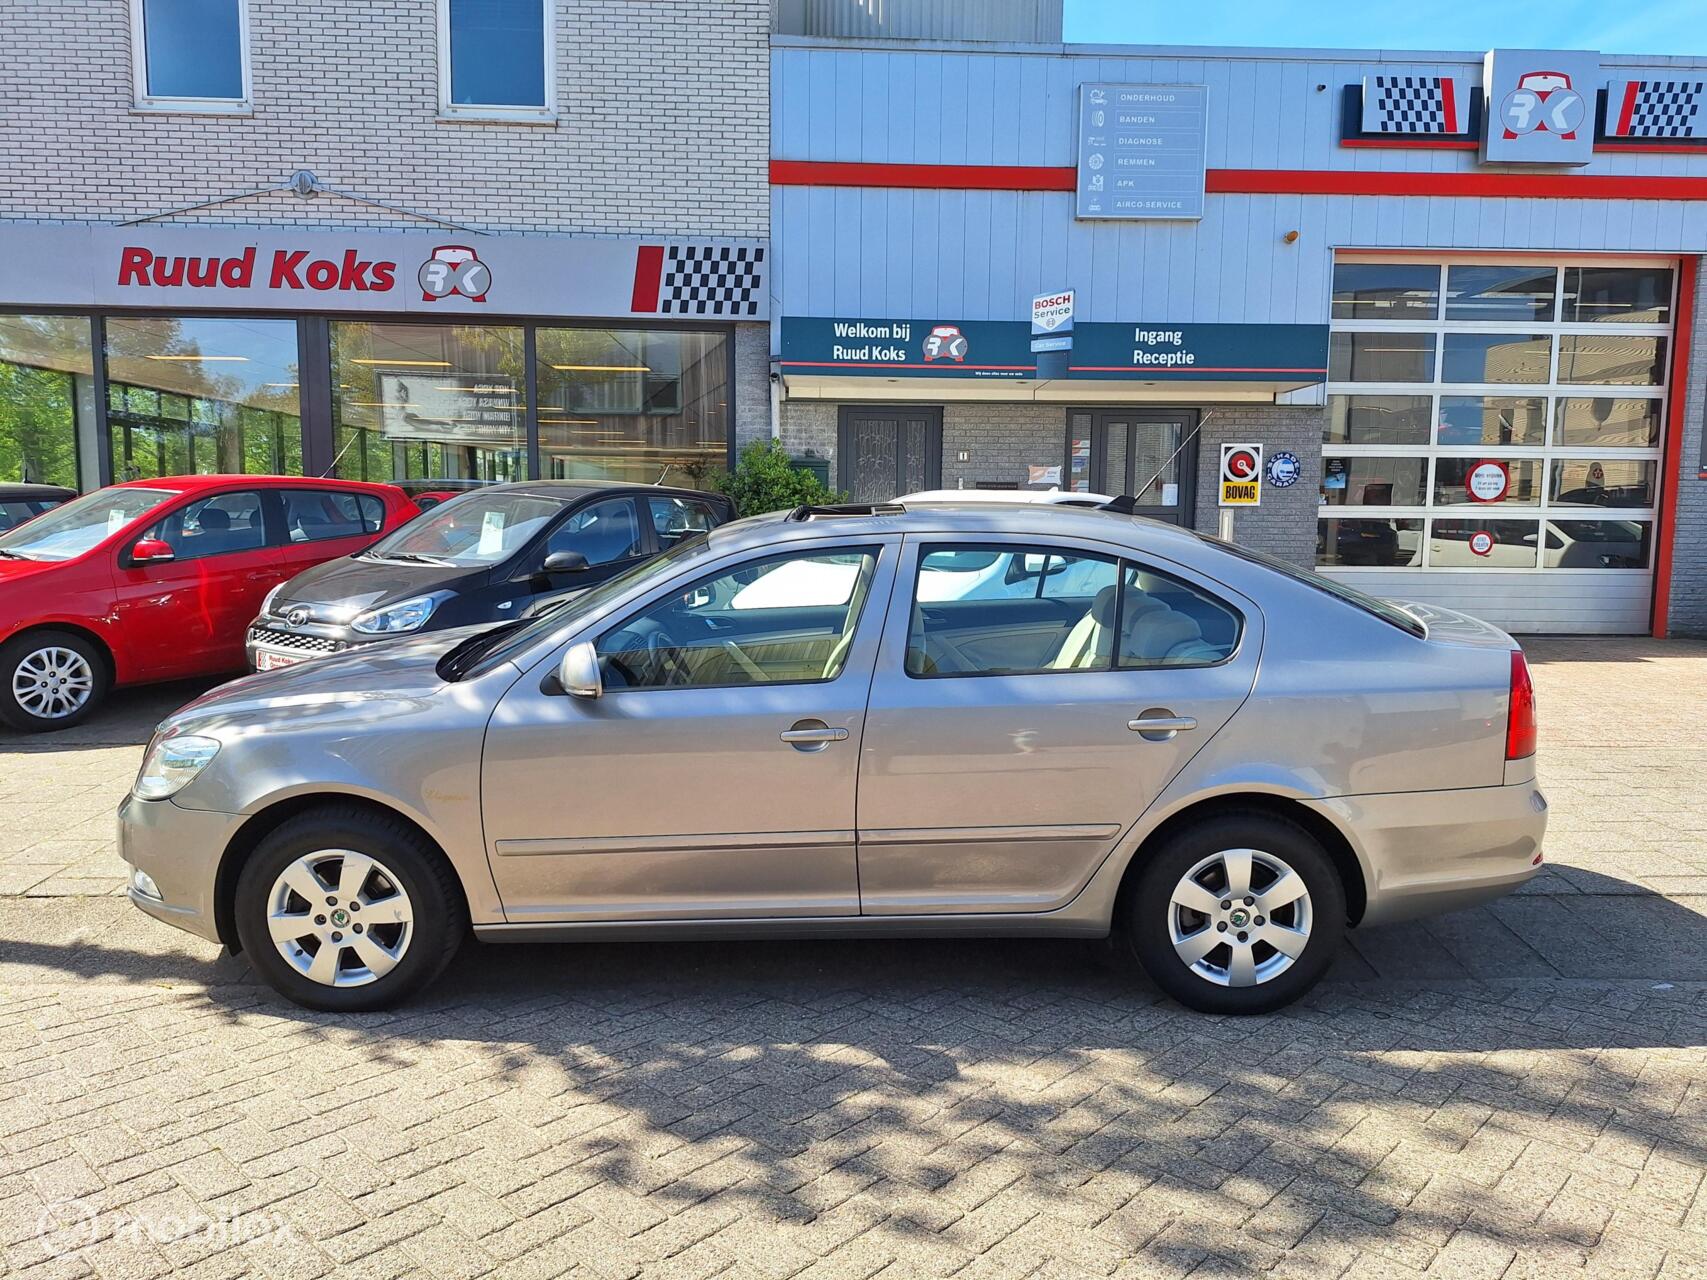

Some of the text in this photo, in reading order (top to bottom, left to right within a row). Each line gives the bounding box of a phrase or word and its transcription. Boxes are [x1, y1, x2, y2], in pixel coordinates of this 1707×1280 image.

[1120, 94, 1175, 102] ONDERHOUD
[1118, 137, 1163, 145] DIAGNOSE
[1117, 158, 1155, 166] REMMEN
[1116, 179, 1135, 187] APK
[118, 246, 396, 291] Ruud Koks
[1034, 294, 1071, 310] BOSCH
[1034, 306, 1071, 319] Service
[834, 323, 910, 341] Welkom bij
[1135, 328, 1183, 345] Ingang
[833, 345, 906, 361] Ruud Koks
[1133, 349, 1195, 367] Receptie
[1267, 453, 1300, 468] SCHADE
[1267, 472, 1298, 487] GARANT
[1225, 485, 1256, 499] BOVAG
